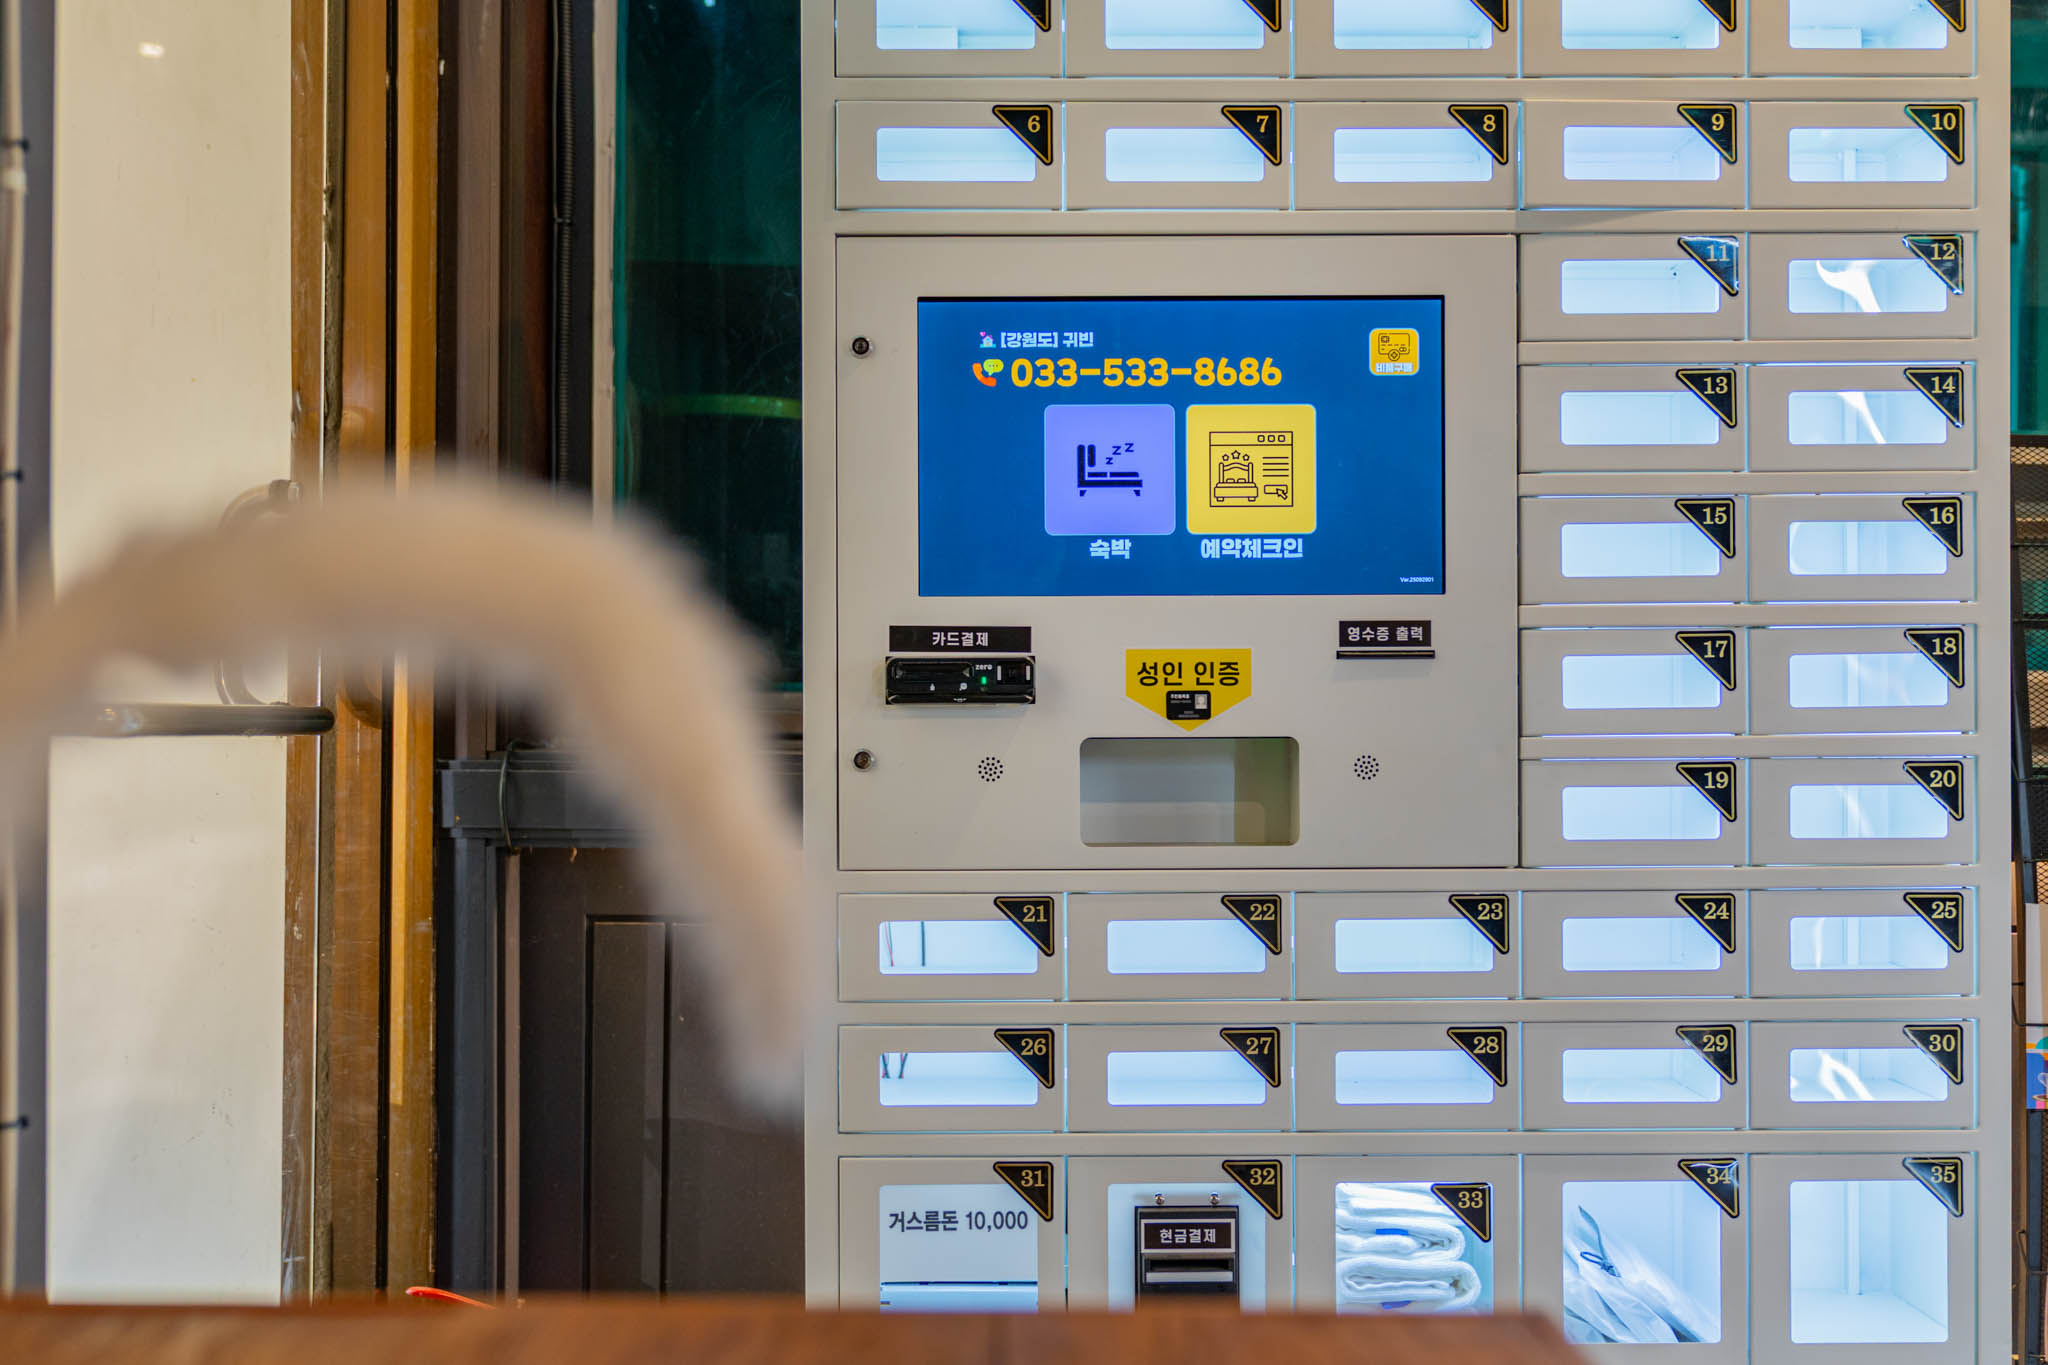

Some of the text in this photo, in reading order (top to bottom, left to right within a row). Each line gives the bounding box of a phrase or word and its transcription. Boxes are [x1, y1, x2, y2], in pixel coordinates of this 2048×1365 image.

[1027, 114, 1041, 133] 6
[1256, 115, 1269, 133] 7
[1482, 114, 1496, 133] 8
[1711, 113, 1725, 131] 9
[1931, 112, 1957, 131] 10
[1706, 244, 1730, 262] 11
[1930, 242, 1956, 261] 12
[1000, 331, 1095, 348] [강원도] 귀빈
[1011, 356, 1283, 387] 033-533-8686
[1703, 376, 1729, 395] 13
[1931, 375, 1956, 394] 14
[1702, 506, 1728, 525] 15
[1929, 506, 1955, 525] 16
[1089, 538, 1132, 559] 숙박
[1200, 538, 1304, 559] 예약체크인
[931, 631, 989, 647] 카드결제
[1347, 626, 1424, 642] 영수증 출력
[1703, 640, 1728, 658] 17
[1932, 637, 1957, 656] 18
[1137, 661, 1240, 687] 성인 인증
[1704, 771, 1729, 789] 19
[1929, 769, 1957, 788] 20
[1022, 904, 1048, 923] 21
[1249, 903, 1275, 921] 22
[1477, 902, 1503, 921] 23
[1703, 901, 1730, 920] 24
[1931, 901, 1957, 919] 25
[1021, 1038, 1047, 1056] 26
[1246, 1037, 1272, 1055] 27
[1473, 1036, 1499, 1054] 28
[1702, 1034, 1729, 1052] 29
[1928, 1034, 1956, 1052] 30
[1021, 1169, 1045, 1187] 31
[1249, 1167, 1275, 1186] 32
[1706, 1166, 1731, 1185] 34
[1929, 1165, 1956, 1184] 35
[1457, 1190, 1483, 1209] 33
[888, 1210, 1029, 1233] 거스름돈 10,000
[1159, 1228, 1217, 1244] 현금결제
